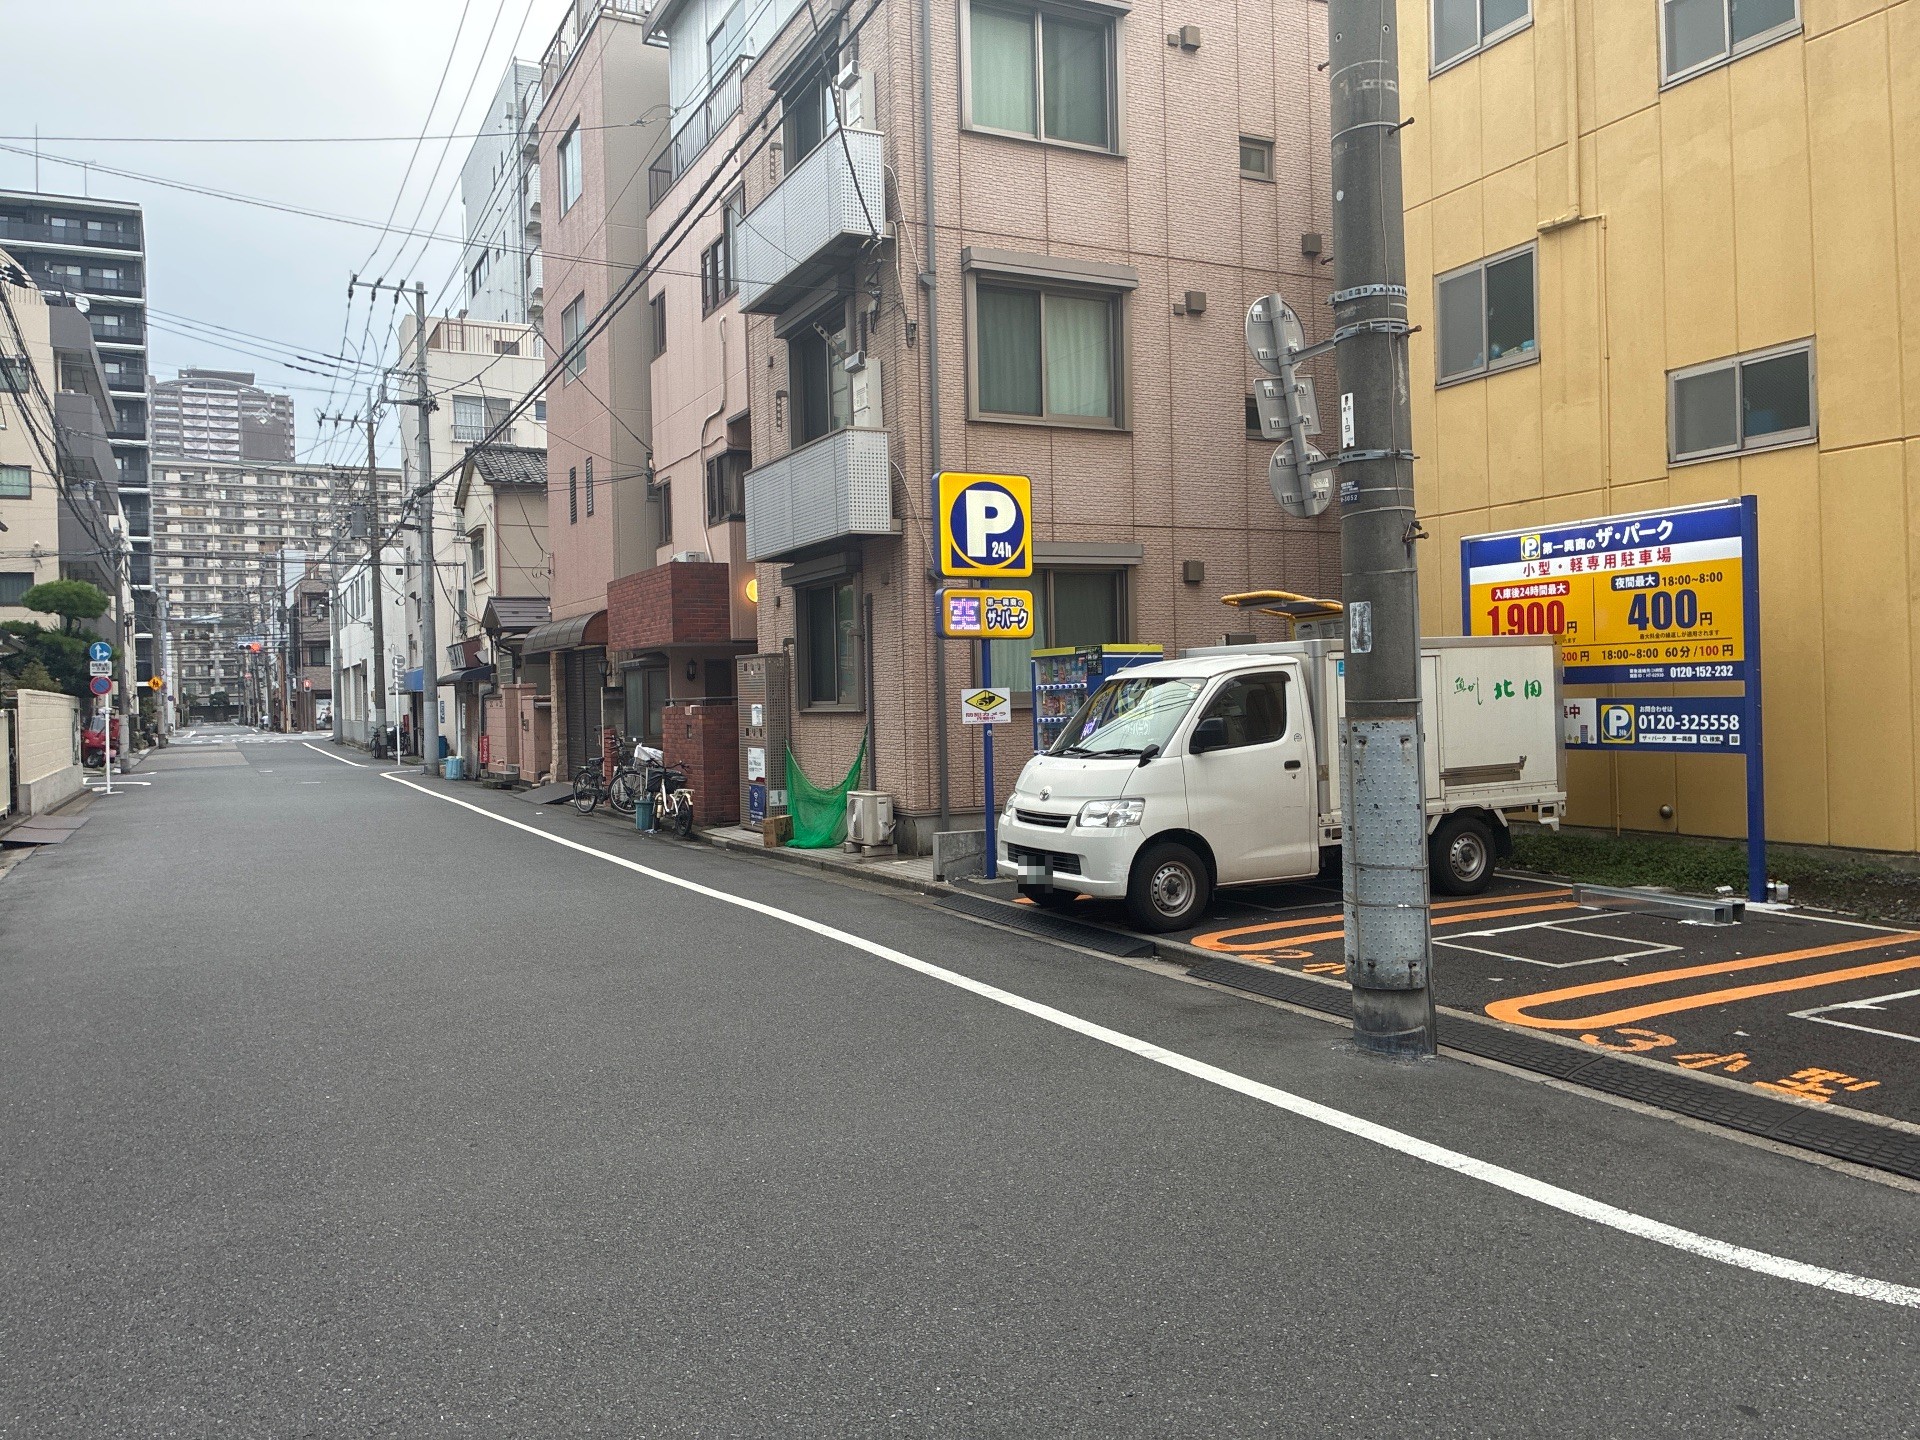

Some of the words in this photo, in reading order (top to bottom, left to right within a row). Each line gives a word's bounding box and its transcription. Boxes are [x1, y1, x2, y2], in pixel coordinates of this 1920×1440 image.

[966, 490, 1016, 557] P
[992, 541, 1011, 557] 24h
[1522, 547, 1672, 578] 小型・軽専用駐車場
[1615, 574, 1656, 589] 夜間最大
[1494, 582, 1567, 600] 入庫後24時間最大
[986, 608, 1029, 630] ザ・パーク
[1670, 665, 1733, 678] 0120-152-232
[1609, 709, 1629, 736] P
[1638, 714, 1739, 731] 0120-325558
